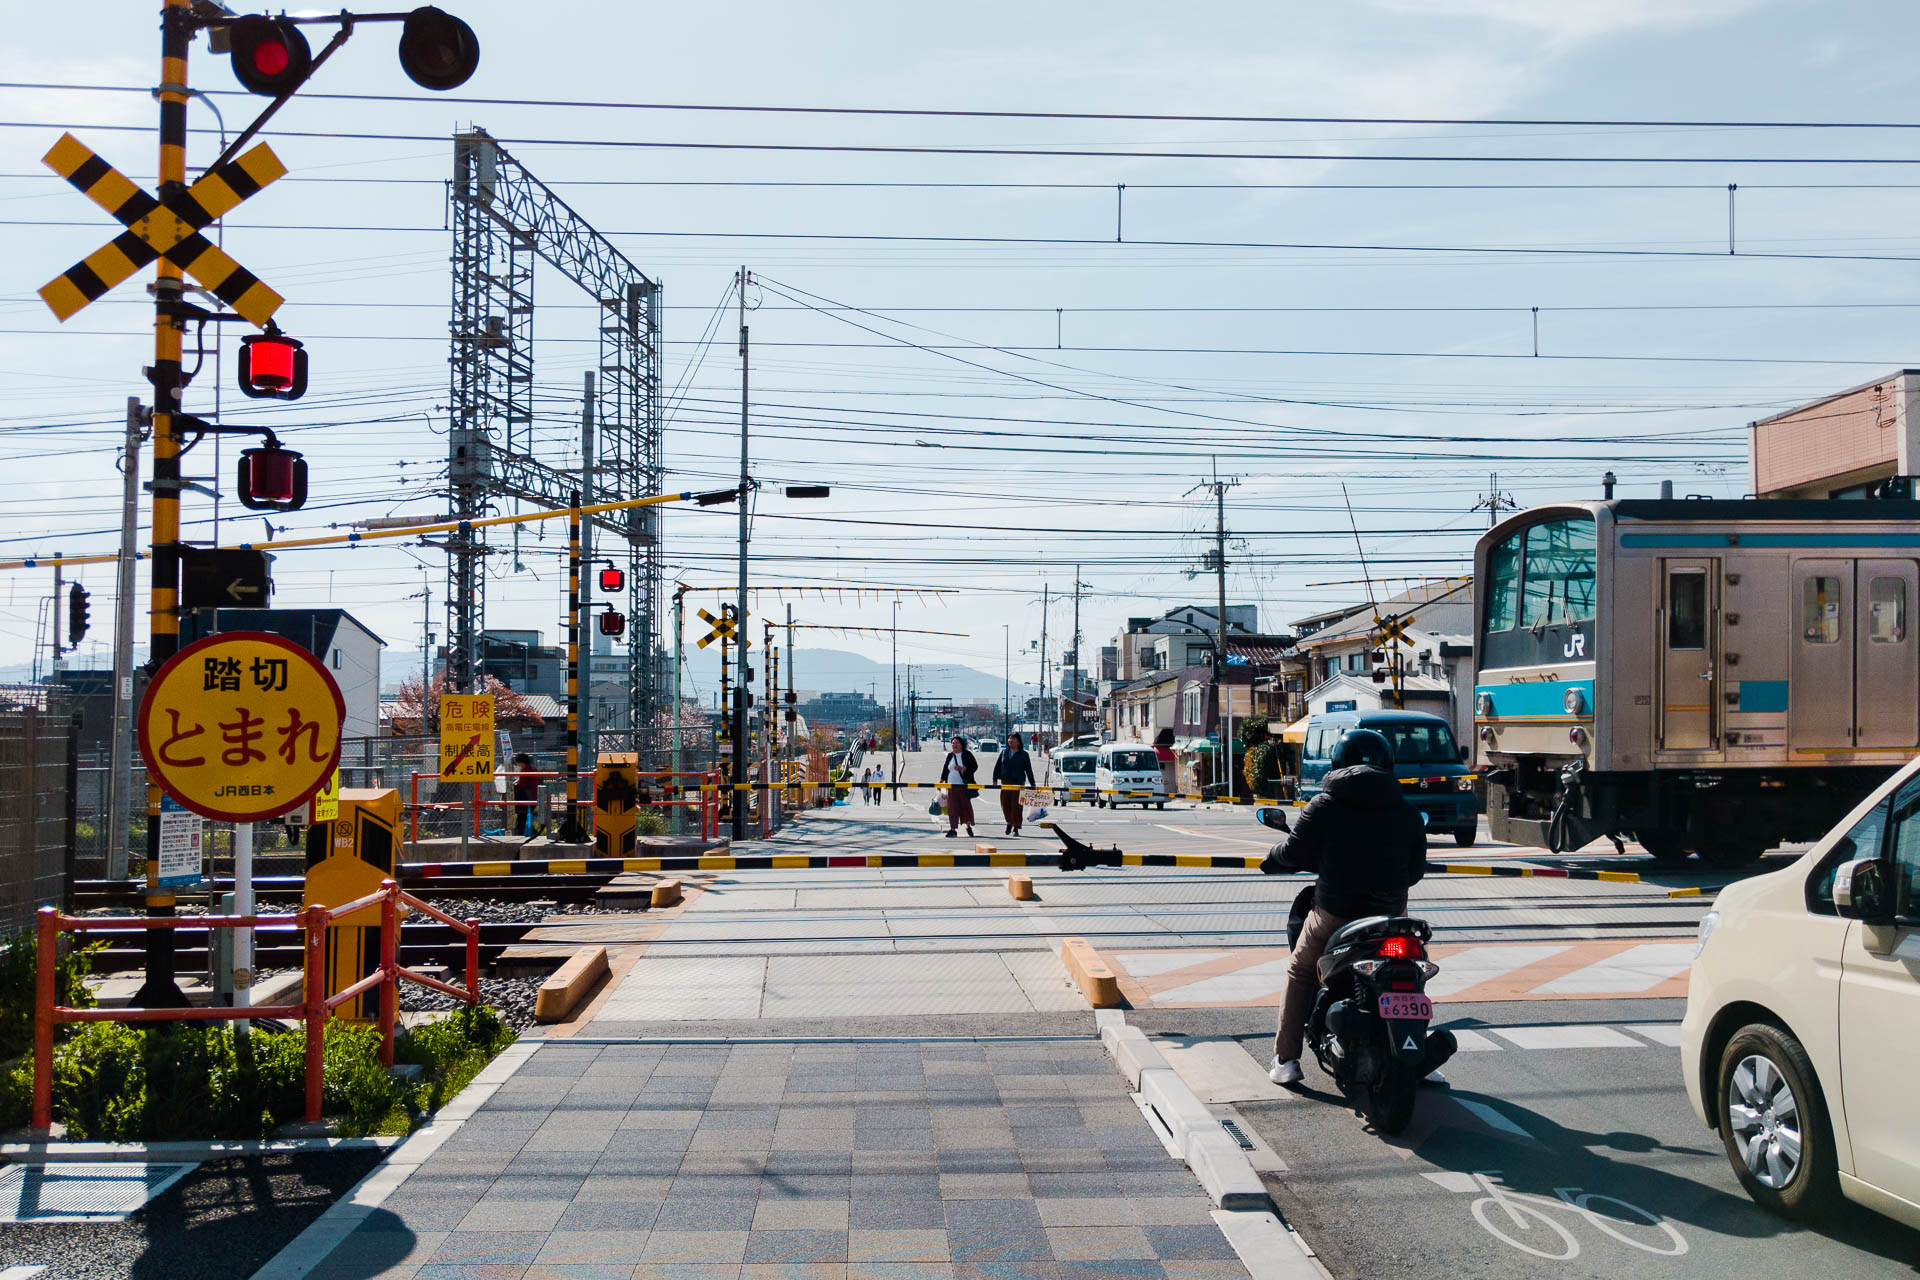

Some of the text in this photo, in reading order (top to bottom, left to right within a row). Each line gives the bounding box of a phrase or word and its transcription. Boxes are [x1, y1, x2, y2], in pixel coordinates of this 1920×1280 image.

[1564, 633, 1585, 657] JR
[203, 656, 288, 692] 踏切
[445, 700, 490, 719] 危険
[158, 707, 330, 768] とまれ
[444, 743, 490, 758] 制限高
[214, 784, 275, 797] JR西日本
[334, 837, 354, 848] WB2
[1392, 1002, 1430, 1016] 6390
